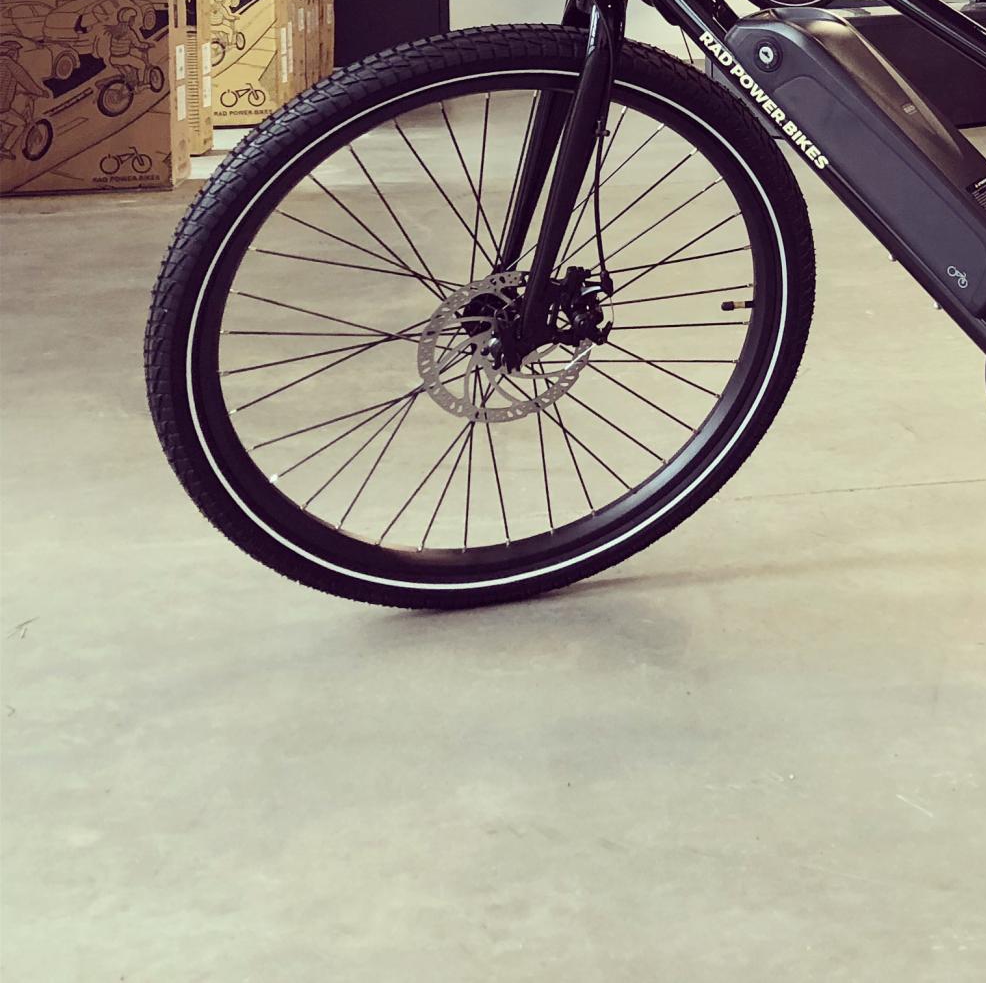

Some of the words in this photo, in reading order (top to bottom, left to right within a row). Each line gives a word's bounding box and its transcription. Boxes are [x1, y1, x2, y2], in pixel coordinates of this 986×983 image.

[699, 30, 733, 66] RAD
[730, 63, 786, 127] POWER
[782, 120, 829, 170] BIKES
